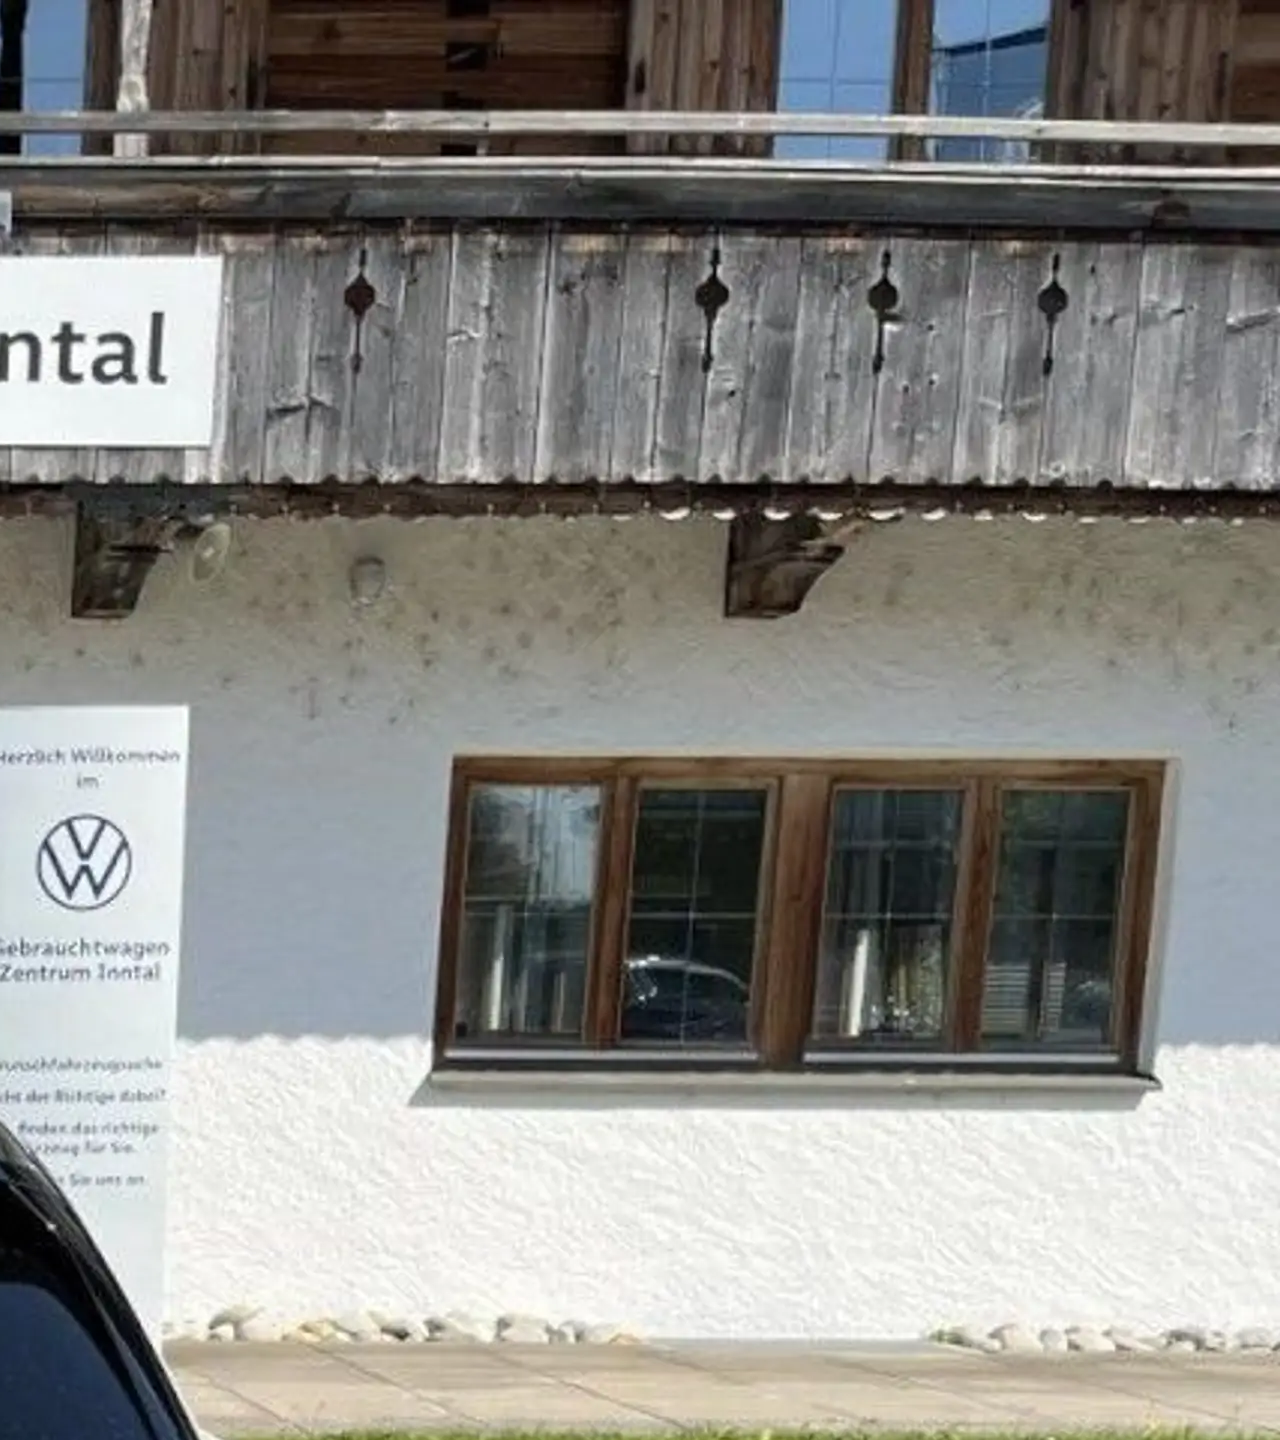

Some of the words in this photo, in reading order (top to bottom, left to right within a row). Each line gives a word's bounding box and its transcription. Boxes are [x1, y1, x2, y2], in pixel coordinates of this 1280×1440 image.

[71, 749, 181, 768] Willkommen
[77, 775, 100, 789] im
[98, 962, 162, 982] Inntal
